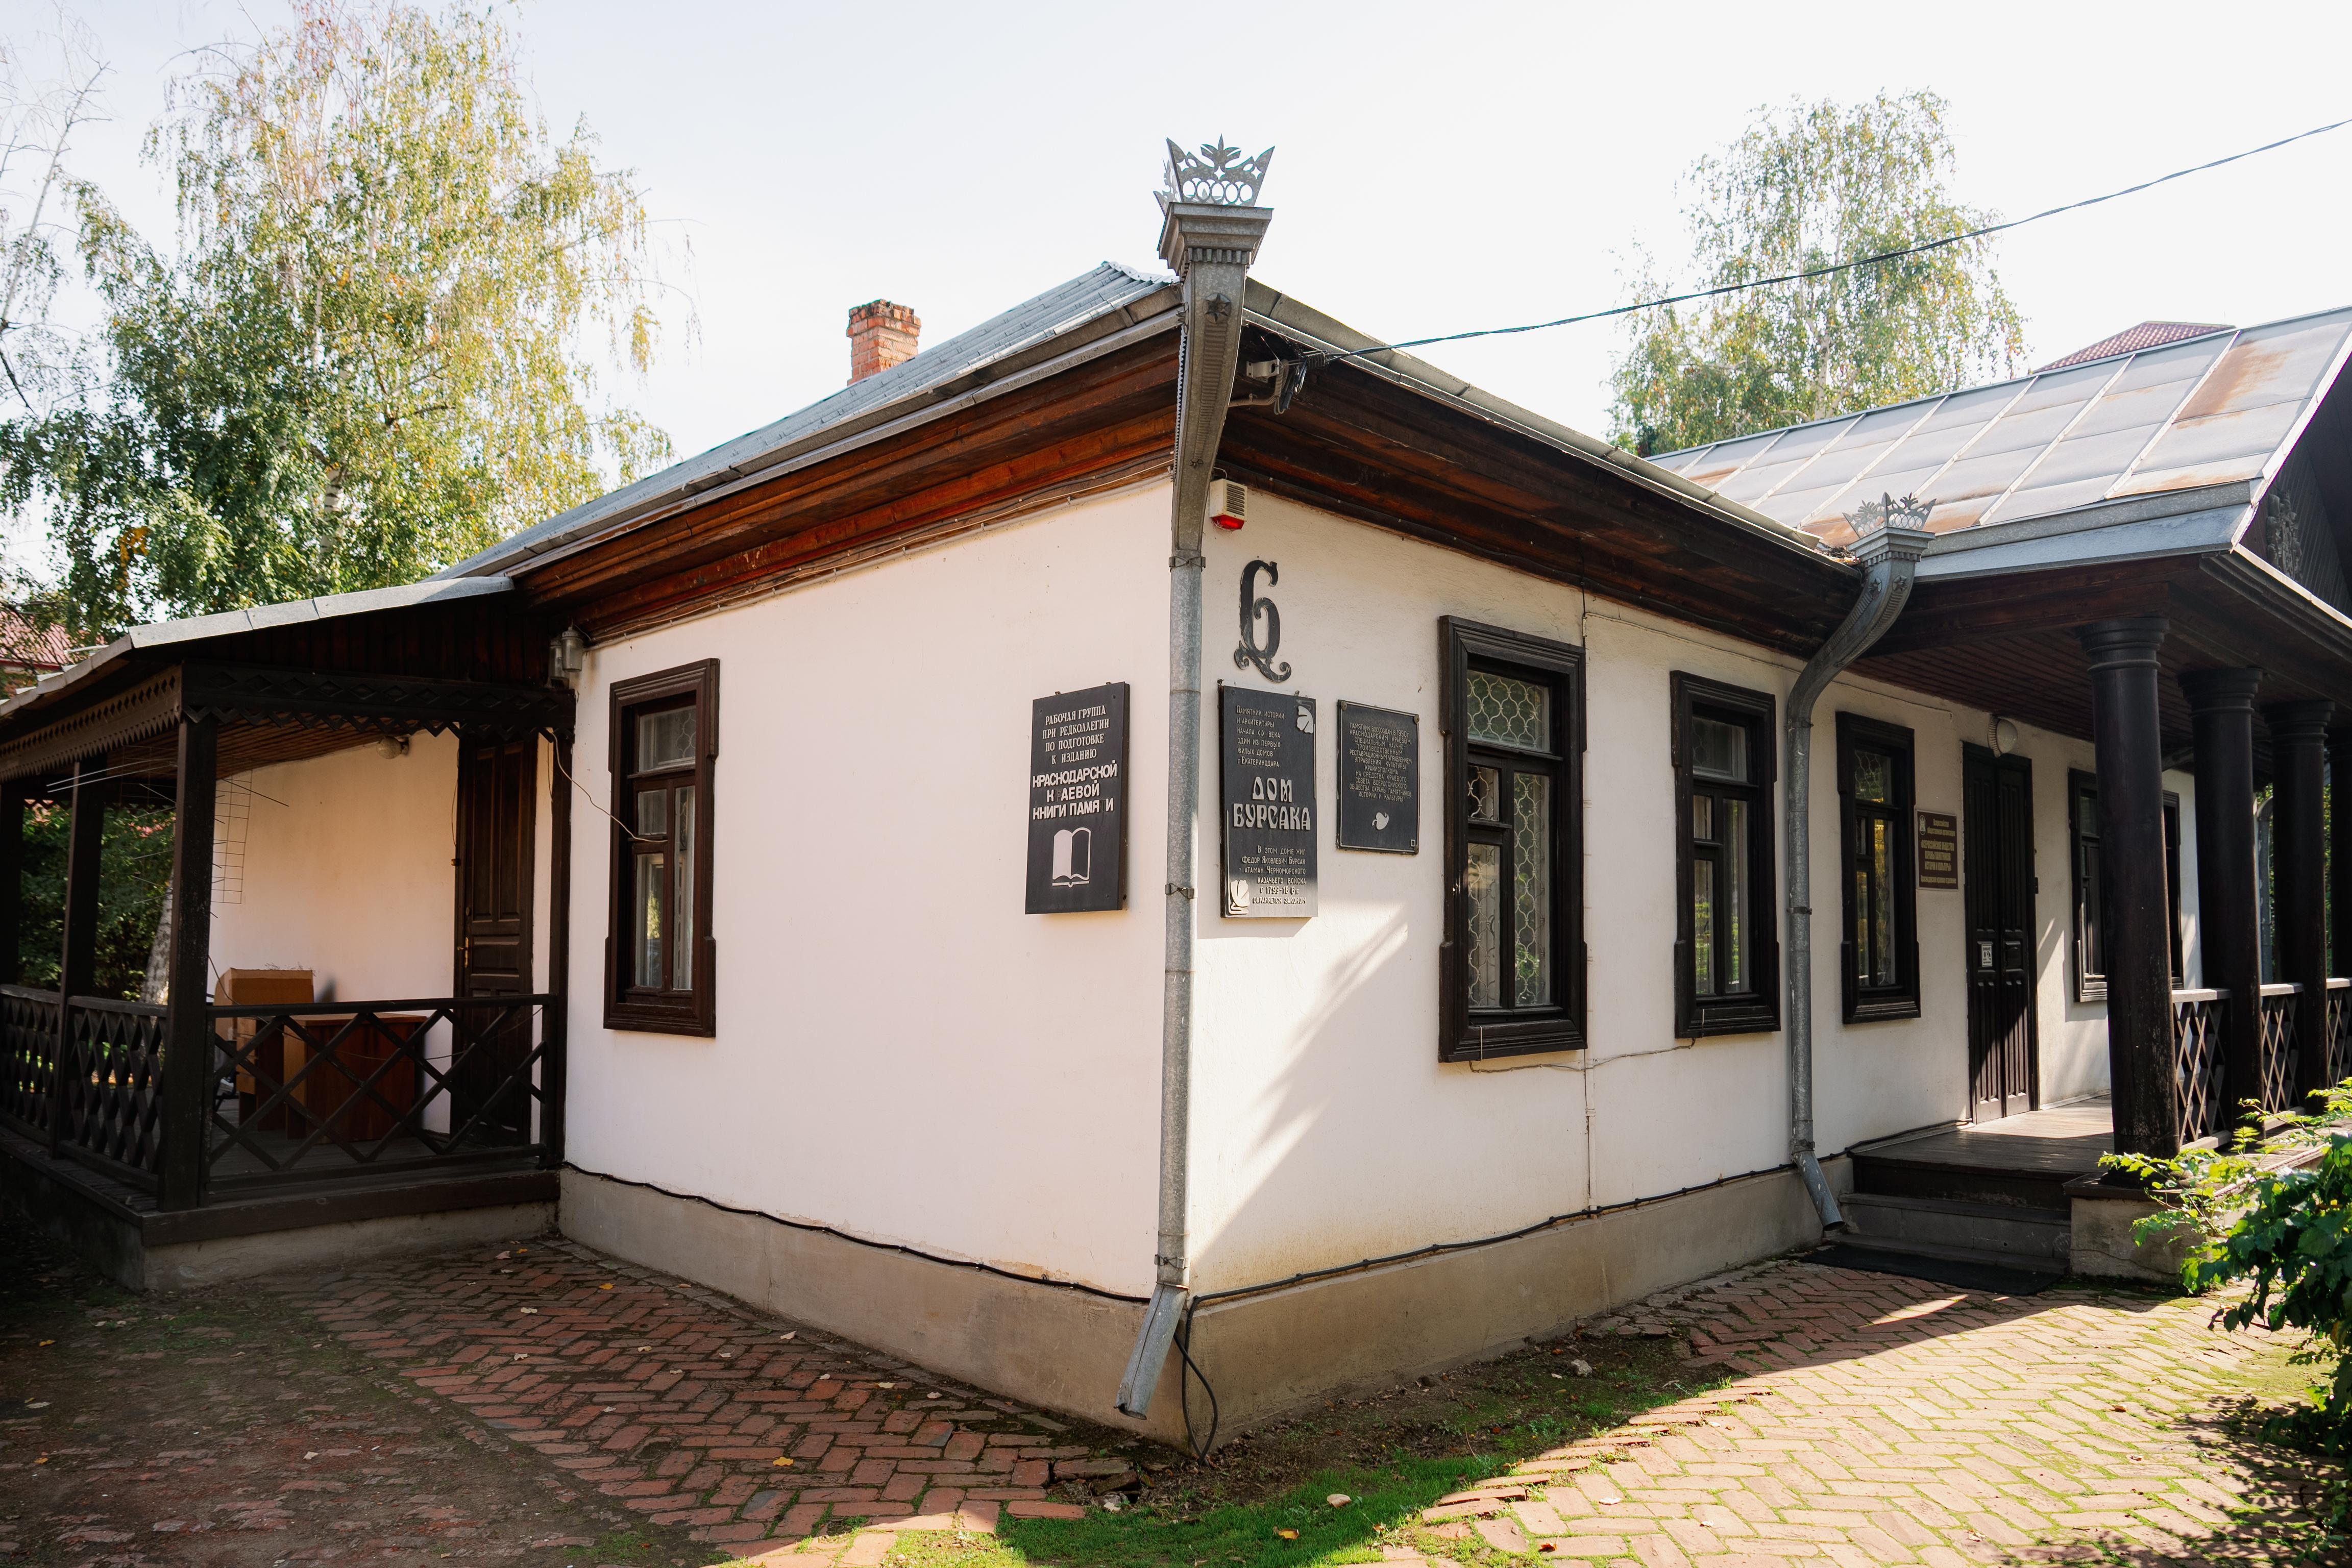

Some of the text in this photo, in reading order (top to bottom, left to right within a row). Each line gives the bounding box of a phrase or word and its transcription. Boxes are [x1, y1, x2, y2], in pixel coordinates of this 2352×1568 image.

[1045, 705, 1106, 725] РАБОЧАЯ ГРУППА
[1264, 710, 1285, 719] ИСТОРИИ
[1043, 719, 1110, 739] ПРИ РЕДКОЛЛЕГИИ
[1242, 718, 1275, 728] АРХИТЕКТУРЫ
[1350, 722, 1370, 731] ПАМЯТНИК
[1371, 726, 1392, 735] ВОССОЗДАН
[1045, 733, 1105, 752] ПО ПОДГОТОВКЕ
[1350, 729, 1411, 745] КРАСНОДАРСКИМ КРАЕВЫМ
[1354, 737, 1385, 747] СПЕЦИАЛЬНЫМ
[1261, 740, 1281, 748] ПЕРВЫХ
[1356, 744, 1403, 756] ПРОИЗВОДСТВЕННЫМ
[1051, 748, 1097, 764] К ИЗДАНИЮ
[1354, 756, 1406, 770] УПРАВЛЕНИЯ КУЛЬТУРЫ
[1033, 760, 1117, 788] КРАСНОДАРСКОЙ
[1363, 771, 1384, 779] СРЕДСТВА
[1253, 776, 1292, 802] ДОМ
[1372, 786, 1387, 794] ОХРАНЫ
[1033, 804, 1066, 820] КНИГИ
[1233, 803, 1311, 830] БУРСАКА
[1258, 845, 1262, 853] В
[1287, 876, 1306, 885] ВОЙСКА
